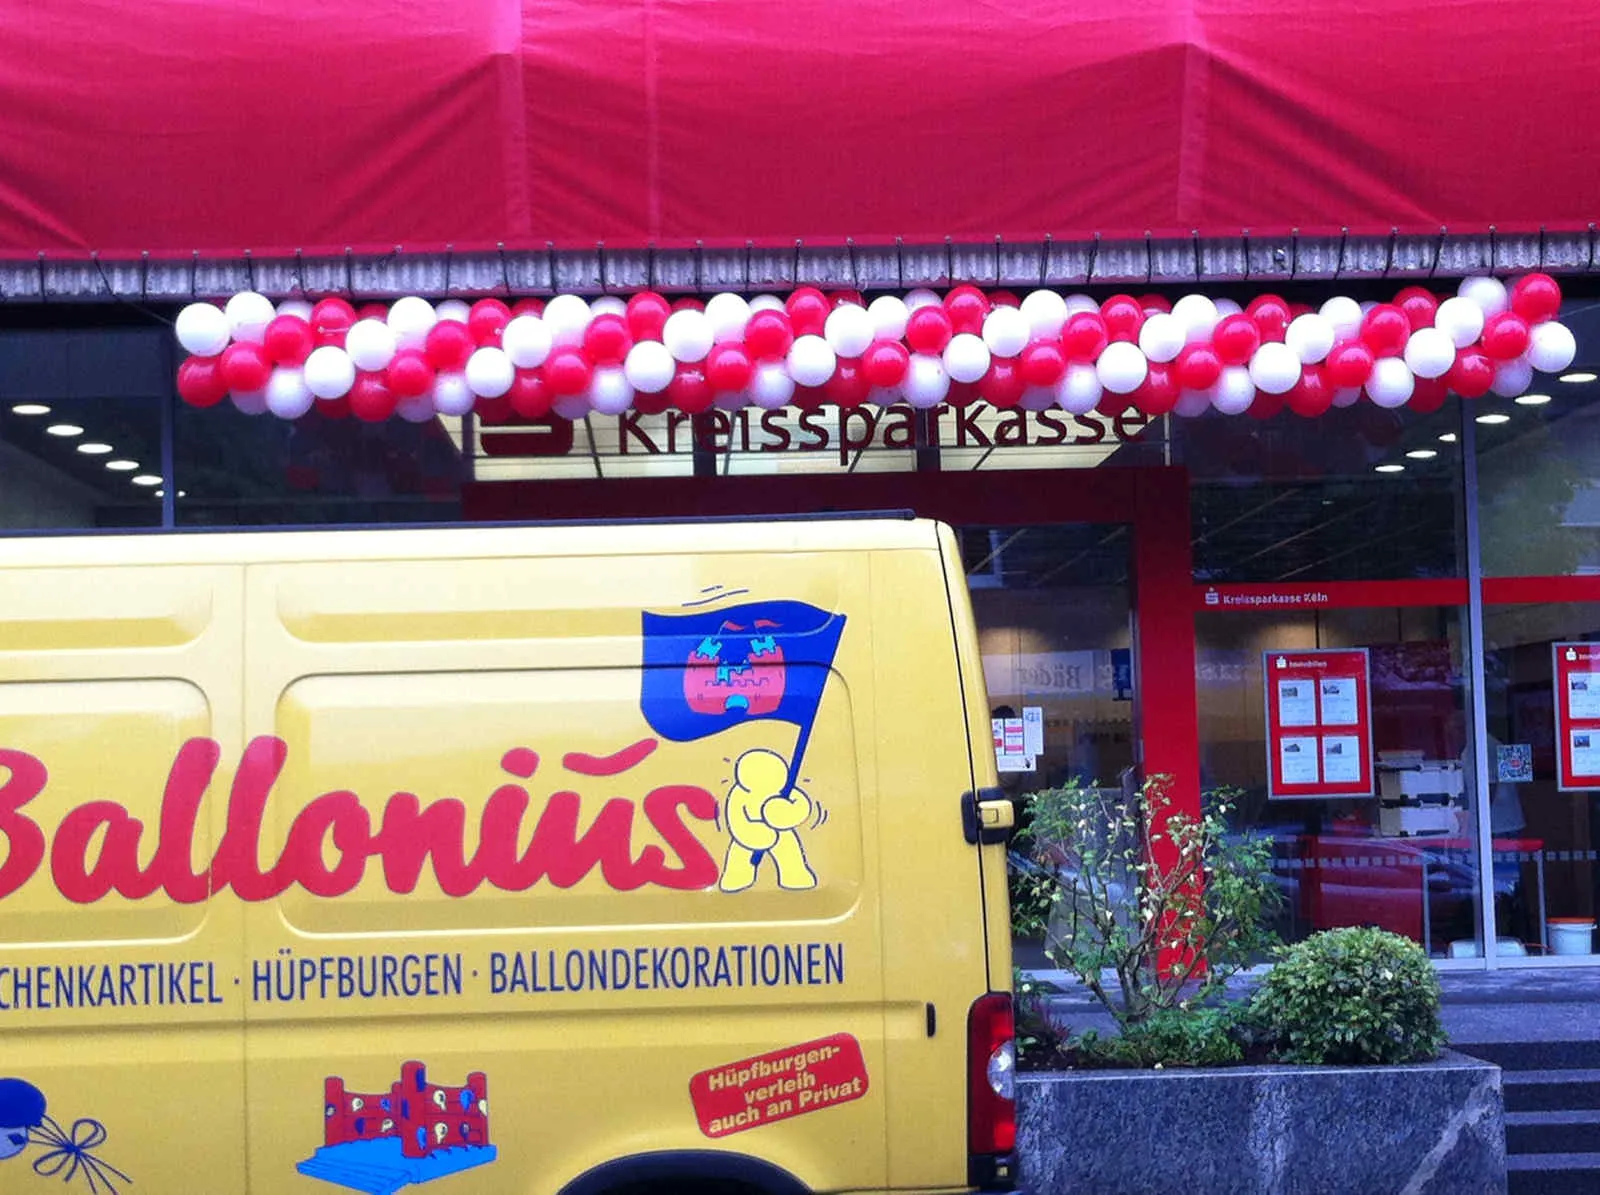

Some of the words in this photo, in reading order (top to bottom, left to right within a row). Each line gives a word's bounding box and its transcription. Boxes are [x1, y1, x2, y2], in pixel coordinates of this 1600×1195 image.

[1224, 592, 1301, 605] Kreissparkasse
[1304, 591, 1328, 603] Köln
[0, 961, 223, 1009] CHENKARTIKEL
[253, 948, 462, 1002] HÜPFBURGEN
[490, 943, 844, 995] BALLONDEKORATIONEN
[708, 1045, 841, 1092] Hüpfburgen-
[744, 1071, 816, 1104] verleih
[708, 1105, 760, 1134] auch
[766, 1098, 793, 1117] an
[799, 1076, 862, 1109] Privat
